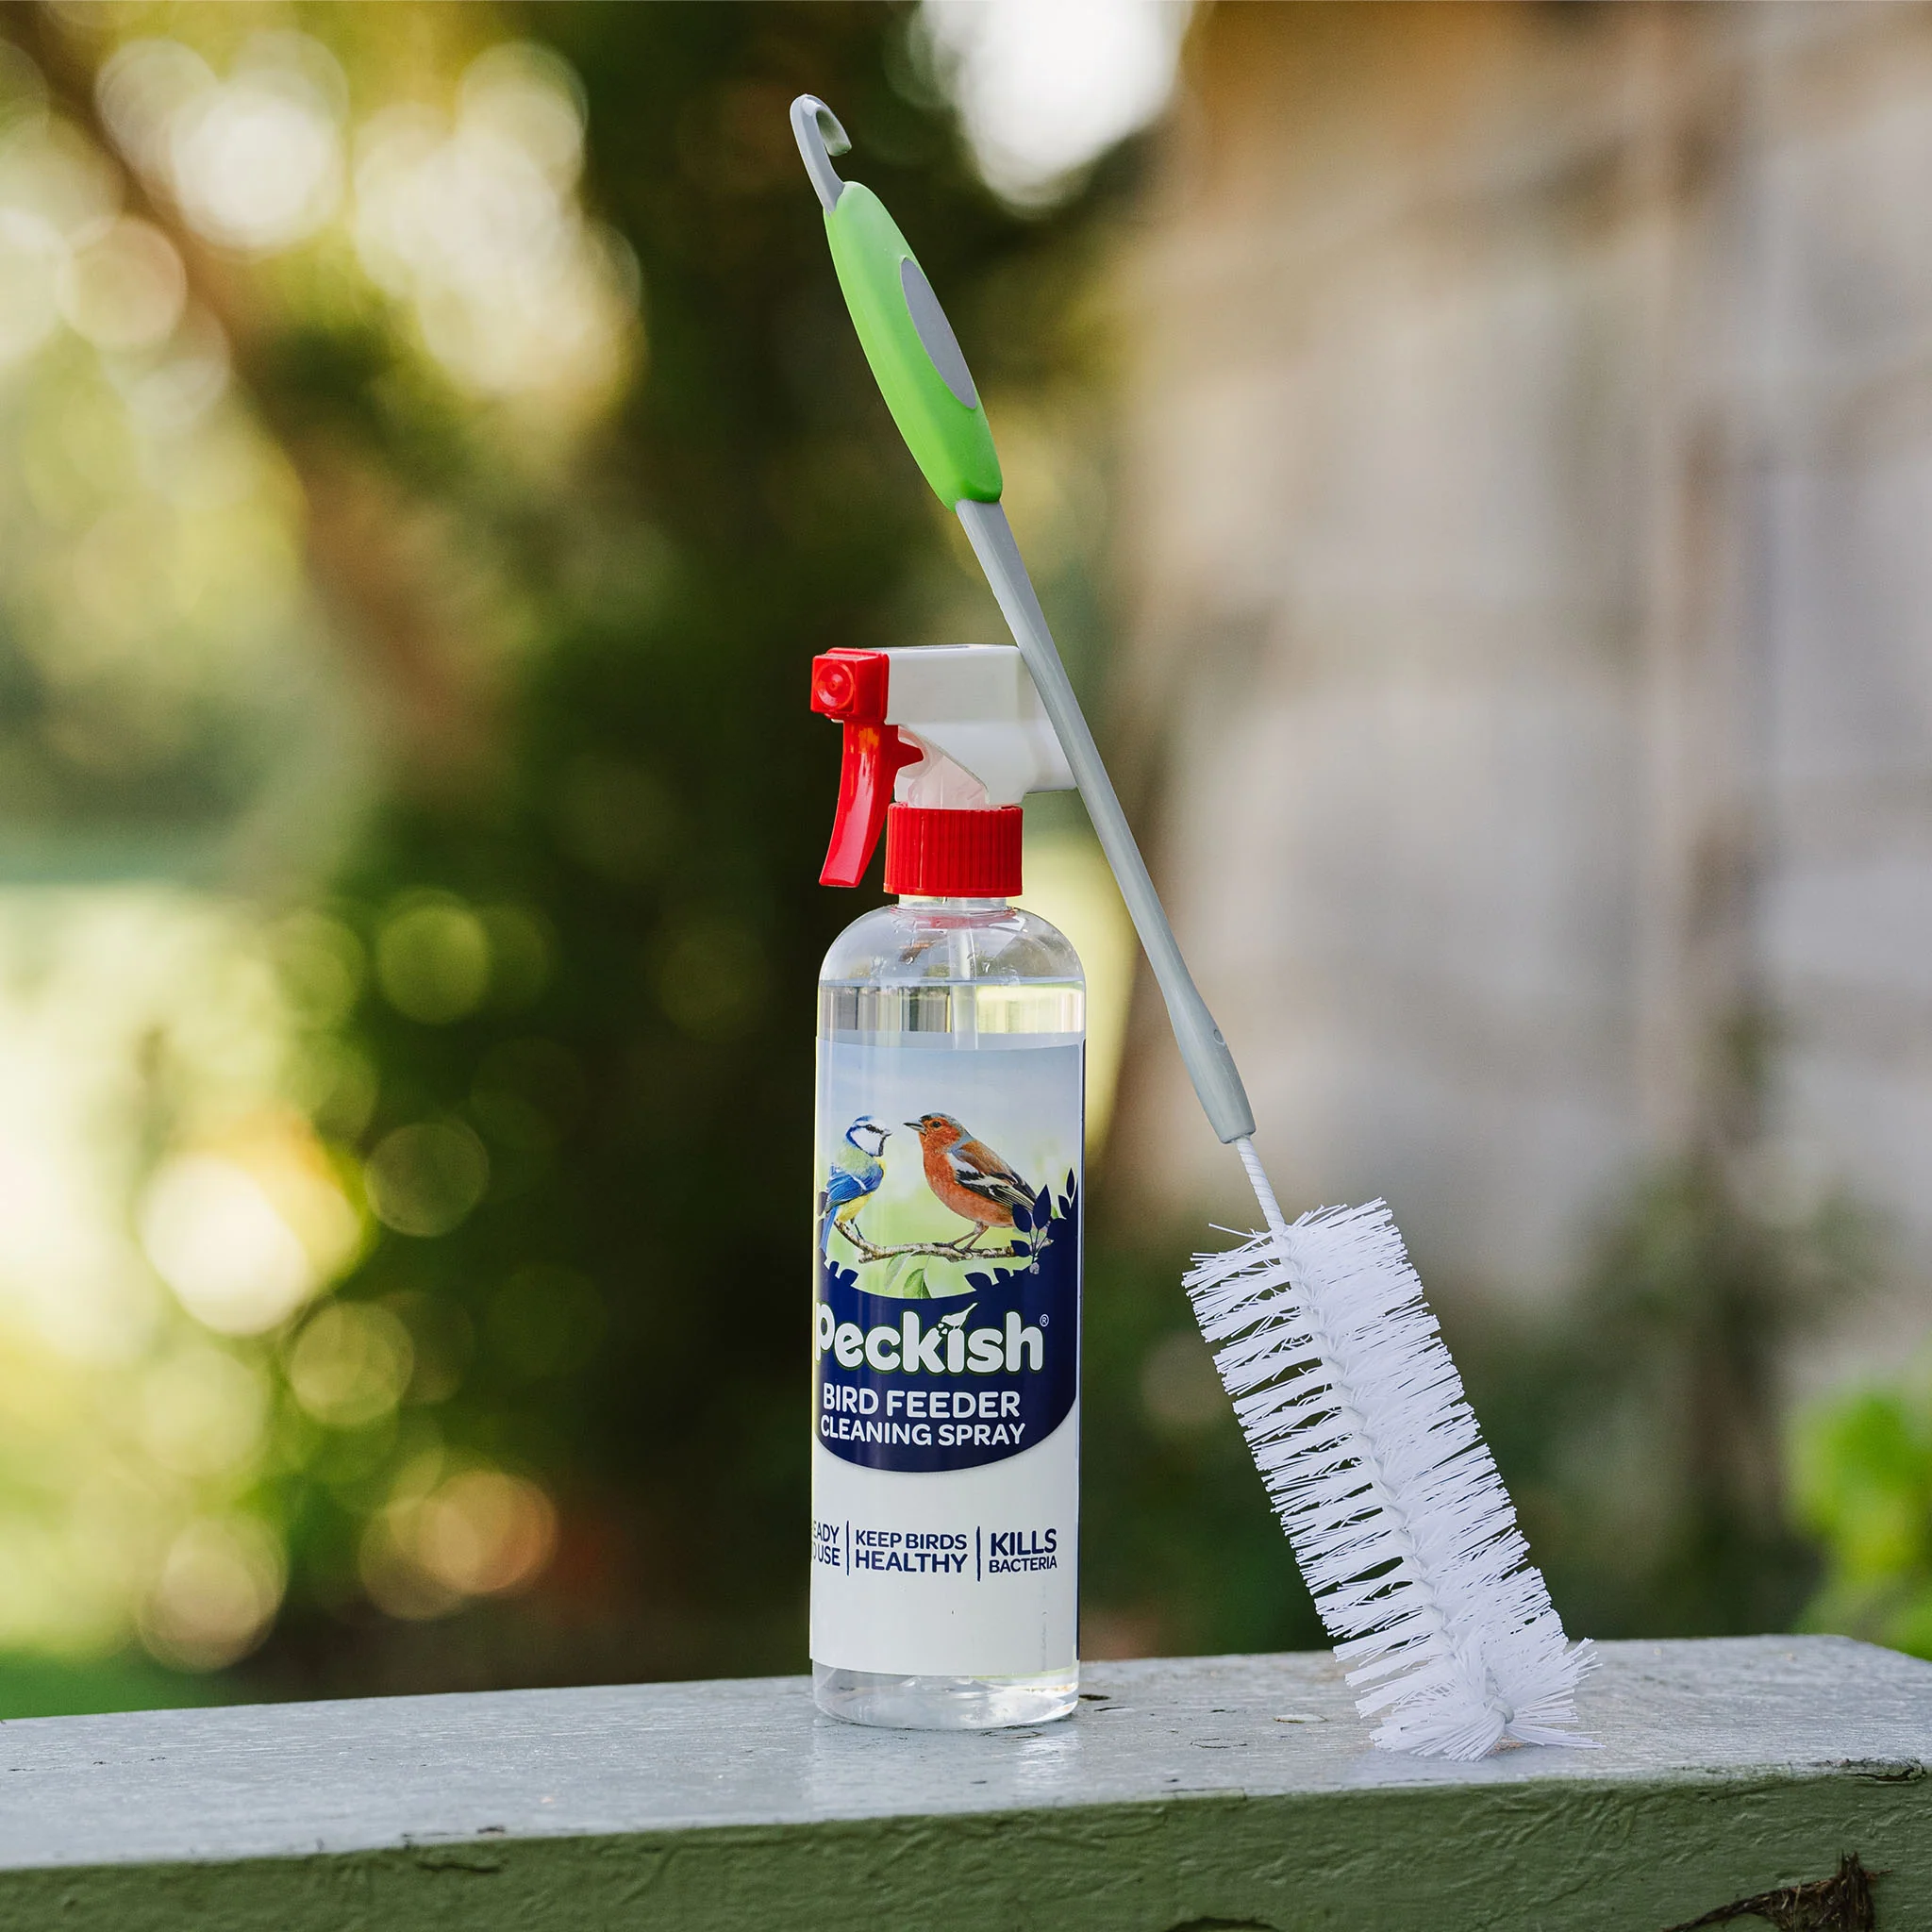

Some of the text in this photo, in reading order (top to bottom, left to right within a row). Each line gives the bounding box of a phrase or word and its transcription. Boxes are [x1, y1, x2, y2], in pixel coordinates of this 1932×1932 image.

[823, 1382, 1022, 1419] BIRD FEEDER
[820, 1415, 1026, 1446] CLEANING SPRAY
[855, 1529, 968, 1551] KEEP BIRDS
[991, 1528, 1058, 1557] KILLS
[855, 1549, 969, 1574] HEALTHY
[989, 1557, 1058, 1574] BACTERIA
